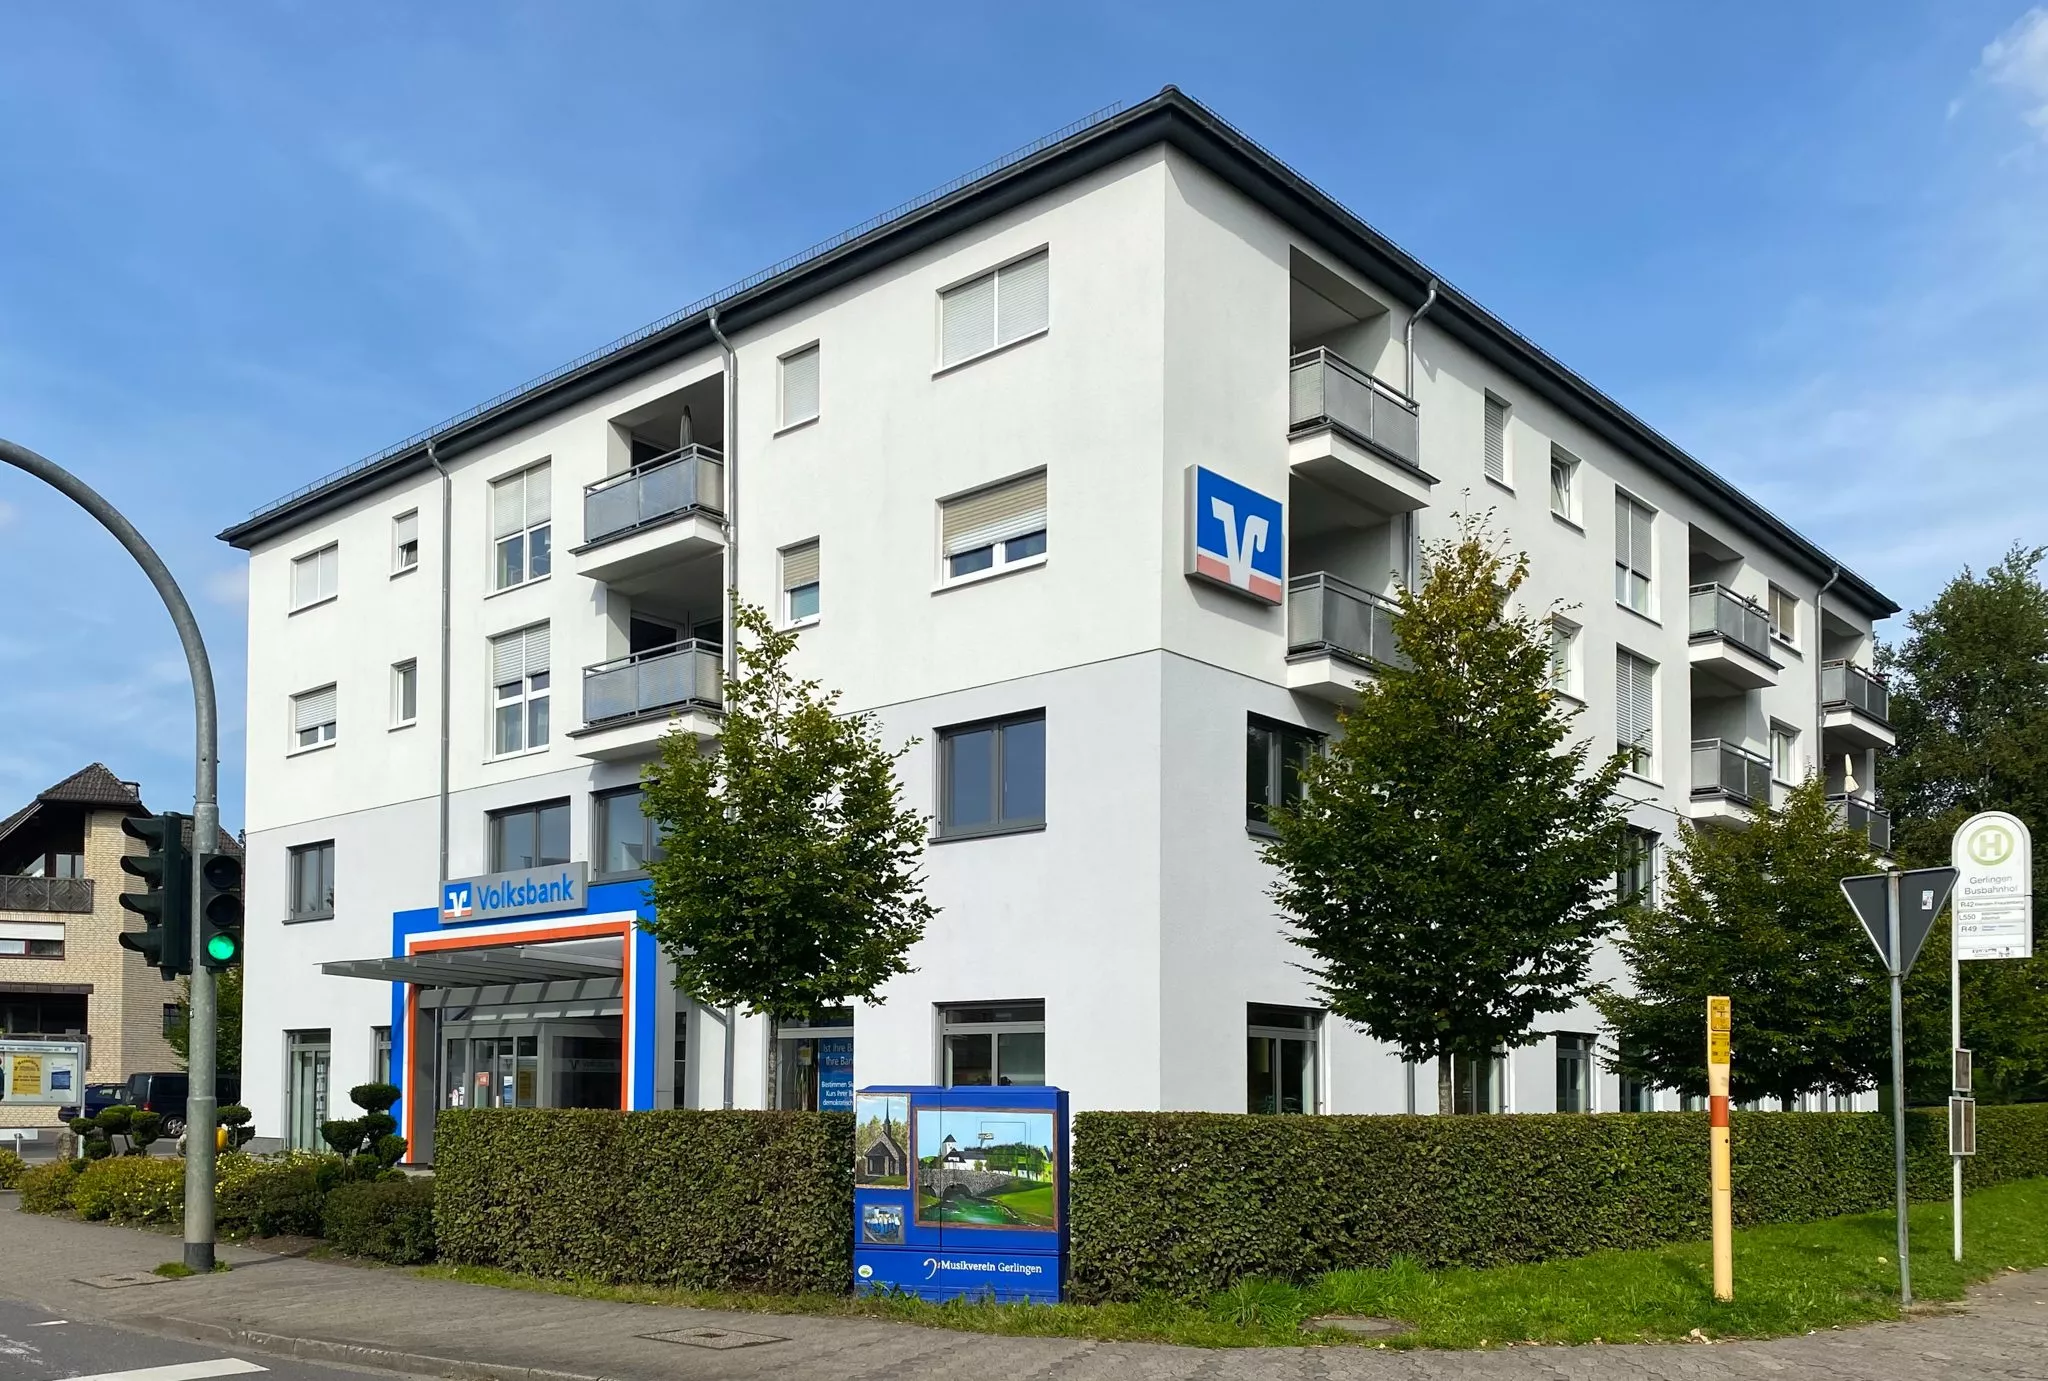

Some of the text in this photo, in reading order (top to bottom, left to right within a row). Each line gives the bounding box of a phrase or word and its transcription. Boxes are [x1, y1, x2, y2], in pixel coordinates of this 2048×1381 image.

[1979, 834, 2002, 857] H
[1970, 875, 2013, 885] Gerlingen
[476, 873, 575, 910] Volksbank
[1964, 885, 2018, 895] Busbahnhof
[840, 1056, 854, 1066] Ban
[941, 1260, 1042, 1276] Musikverein Gerlingen
